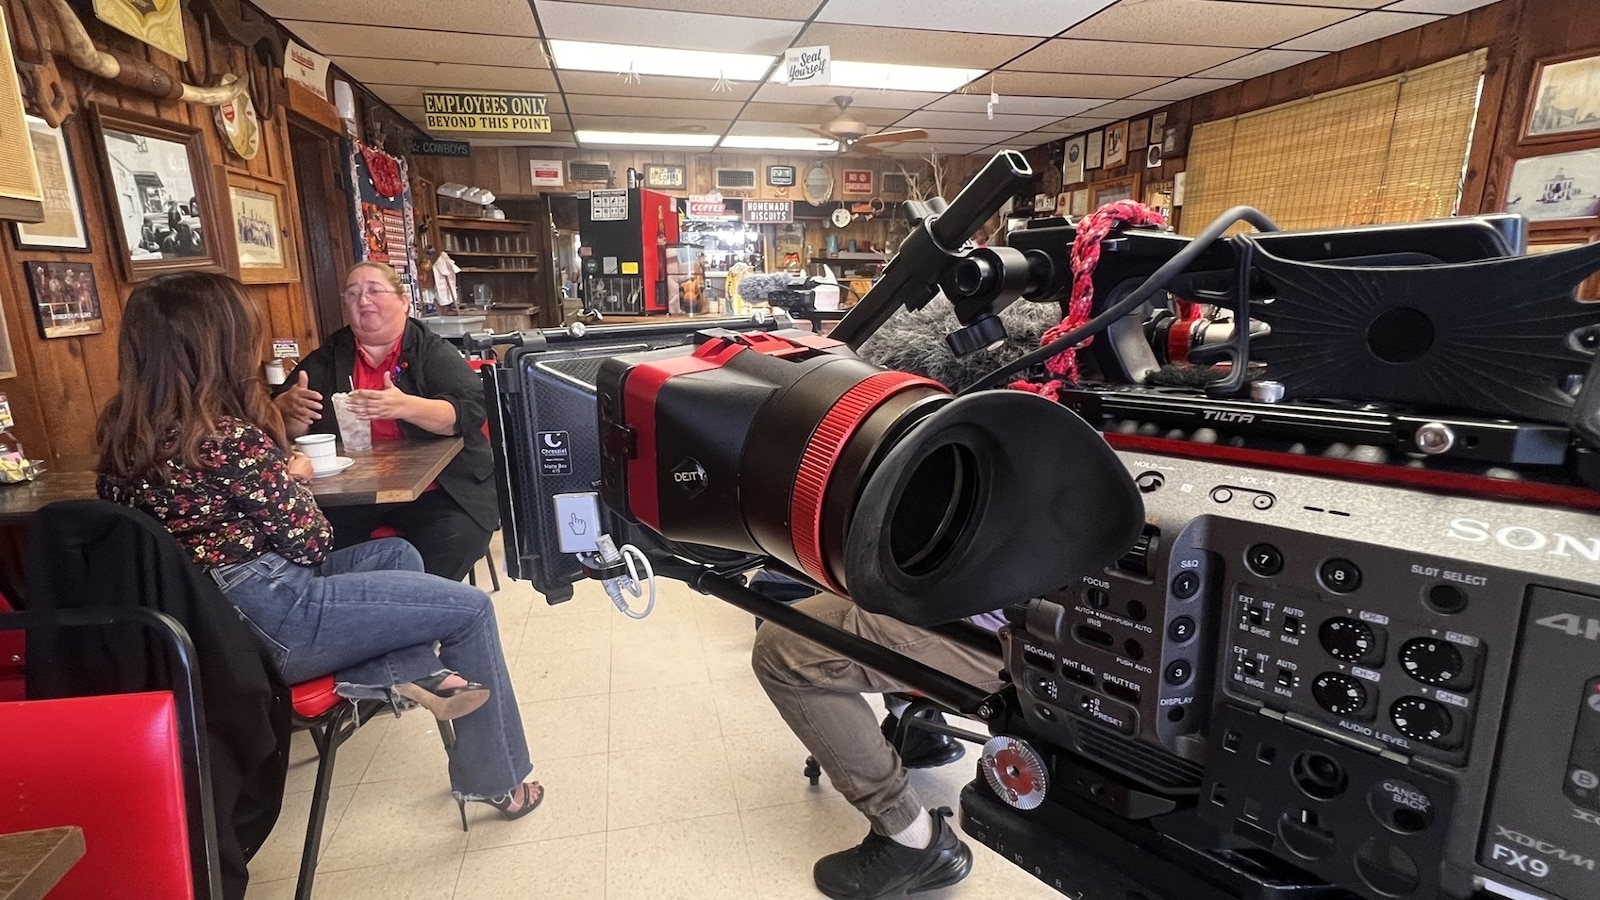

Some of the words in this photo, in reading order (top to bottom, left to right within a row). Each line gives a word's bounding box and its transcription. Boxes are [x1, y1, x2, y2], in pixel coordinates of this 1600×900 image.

[800, 48, 821, 67] Seat
[790, 59, 826, 82] Yourself
[424, 95, 508, 114] EMPLOYEES
[511, 98, 547, 115] ONLY
[428, 116, 476, 128] BEYOND
[479, 117, 508, 128] THIS
[513, 118, 549, 129] POINT
[422, 142, 468, 155] COWBOYS
[845, 182, 871, 190] SMOKING
[691, 203, 726, 212] COFFEE
[747, 202, 789, 211] HOMEMADE
[751, 211, 786, 220] BISCUITS
[1203, 410, 1255, 423] TILTA
[1133, 460, 1157, 469] HOLD
[674, 471, 704, 482] DEITY
[1239, 475, 1259, 485] VOL
[1180, 559, 1199, 569] S&Q
[1260, 554, 1269, 564] 7
[1334, 570, 1345, 580] 8
[1411, 564, 1440, 577] SLOT
[1442, 570, 1488, 587] SELECT
[1082, 575, 1110, 589] FOCUS
[1183, 581, 1189, 590] 1
[1239, 595, 1254, 604] EXT
[1262, 601, 1276, 610] INT
[1282, 606, 1304, 618] AUTO
[1074, 605, 1091, 615] AUTO
[1134, 623, 1153, 634] AUTO
[1086, 617, 1102, 627] IRIS
[1177, 625, 1186, 635] 2
[1239, 623, 1249, 631] MI
[1250, 626, 1271, 638] SHOE
[1280, 635, 1299, 645] MAN
[1023, 644, 1056, 660] ISO/GAIN
[1233, 646, 1248, 655] EXT
[1256, 653, 1270, 662] INT
[1062, 657, 1079, 668] WHT
[1080, 664, 1096, 676] BAL
[1115, 656, 1133, 667] PUSH
[1134, 663, 1153, 674] AUTO
[1276, 659, 1298, 671] AUTO
[1174, 668, 1183, 678] 3
[1353, 668, 1378, 680] CH-2
[1102, 672, 1141, 692] SHUTTER
[1234, 673, 1243, 681] MI
[1245, 676, 1265, 689] SHOE
[1274, 686, 1293, 697] MAN
[1160, 696, 1194, 706] DISPLAY
[1093, 710, 1123, 727] PRESET
[1339, 720, 1372, 736] AUDIO
[1375, 731, 1411, 749] LEVEL
[1579, 772, 1592, 786] B
[1393, 793, 1427, 813] BACK
[1014, 853, 1023, 864] 10
[1492, 843, 1549, 878] FX9
[1035, 866, 1041, 875] 9
[1055, 878, 1062, 888] 8
[1077, 891, 1084, 900] 7
